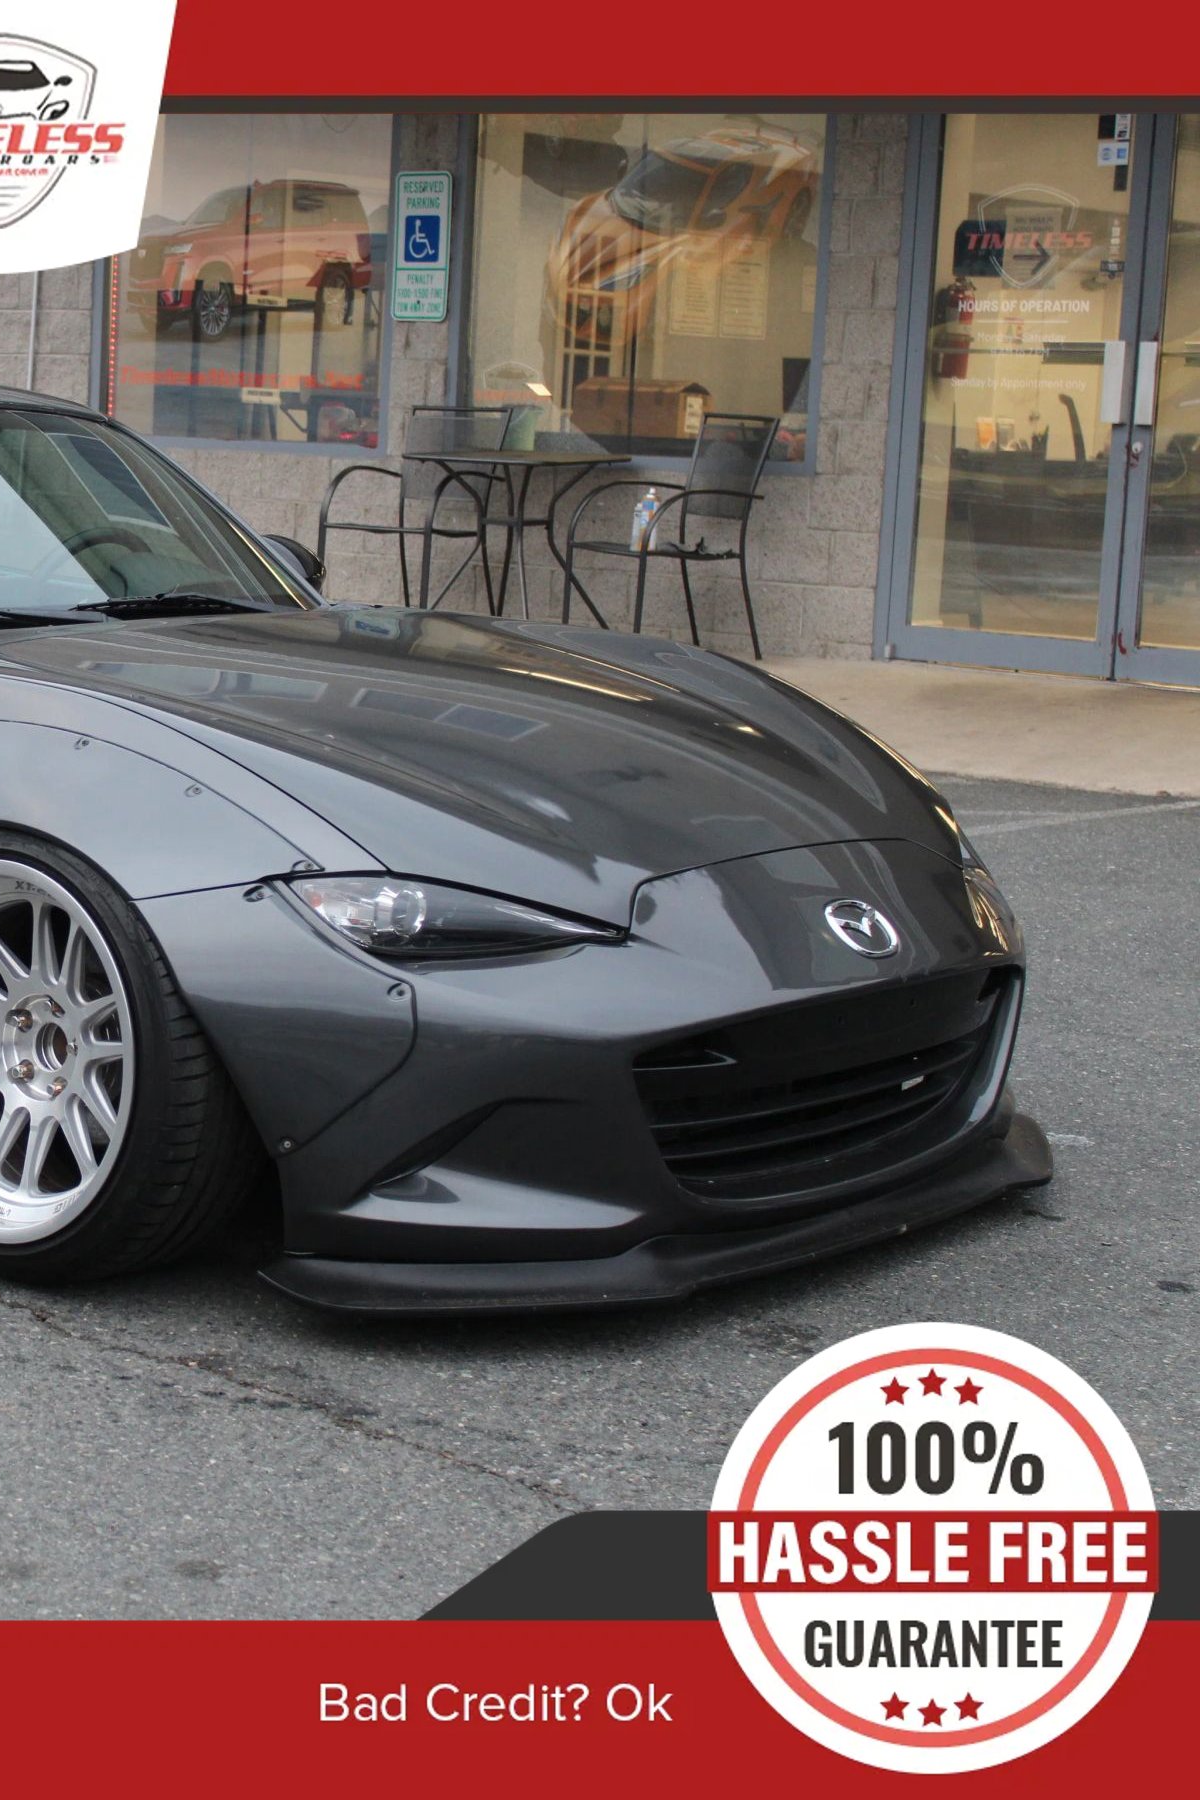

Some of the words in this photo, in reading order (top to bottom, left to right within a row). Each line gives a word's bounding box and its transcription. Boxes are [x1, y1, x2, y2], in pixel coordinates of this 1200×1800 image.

[403, 181, 444, 193] RESERVED
[406, 197, 441, 209] PARKING
[966, 231, 1093, 250] TIMELESS
[407, 274, 434, 285] PENALTY
[957, 300, 999, 313] HOURS
[1001, 300, 1017, 313] OF
[1019, 300, 1091, 313] OPERATION
[951, 376, 985, 389] Sunday
[1000, 378, 1064, 391] Appointment
[1065, 380, 1087, 392] only
